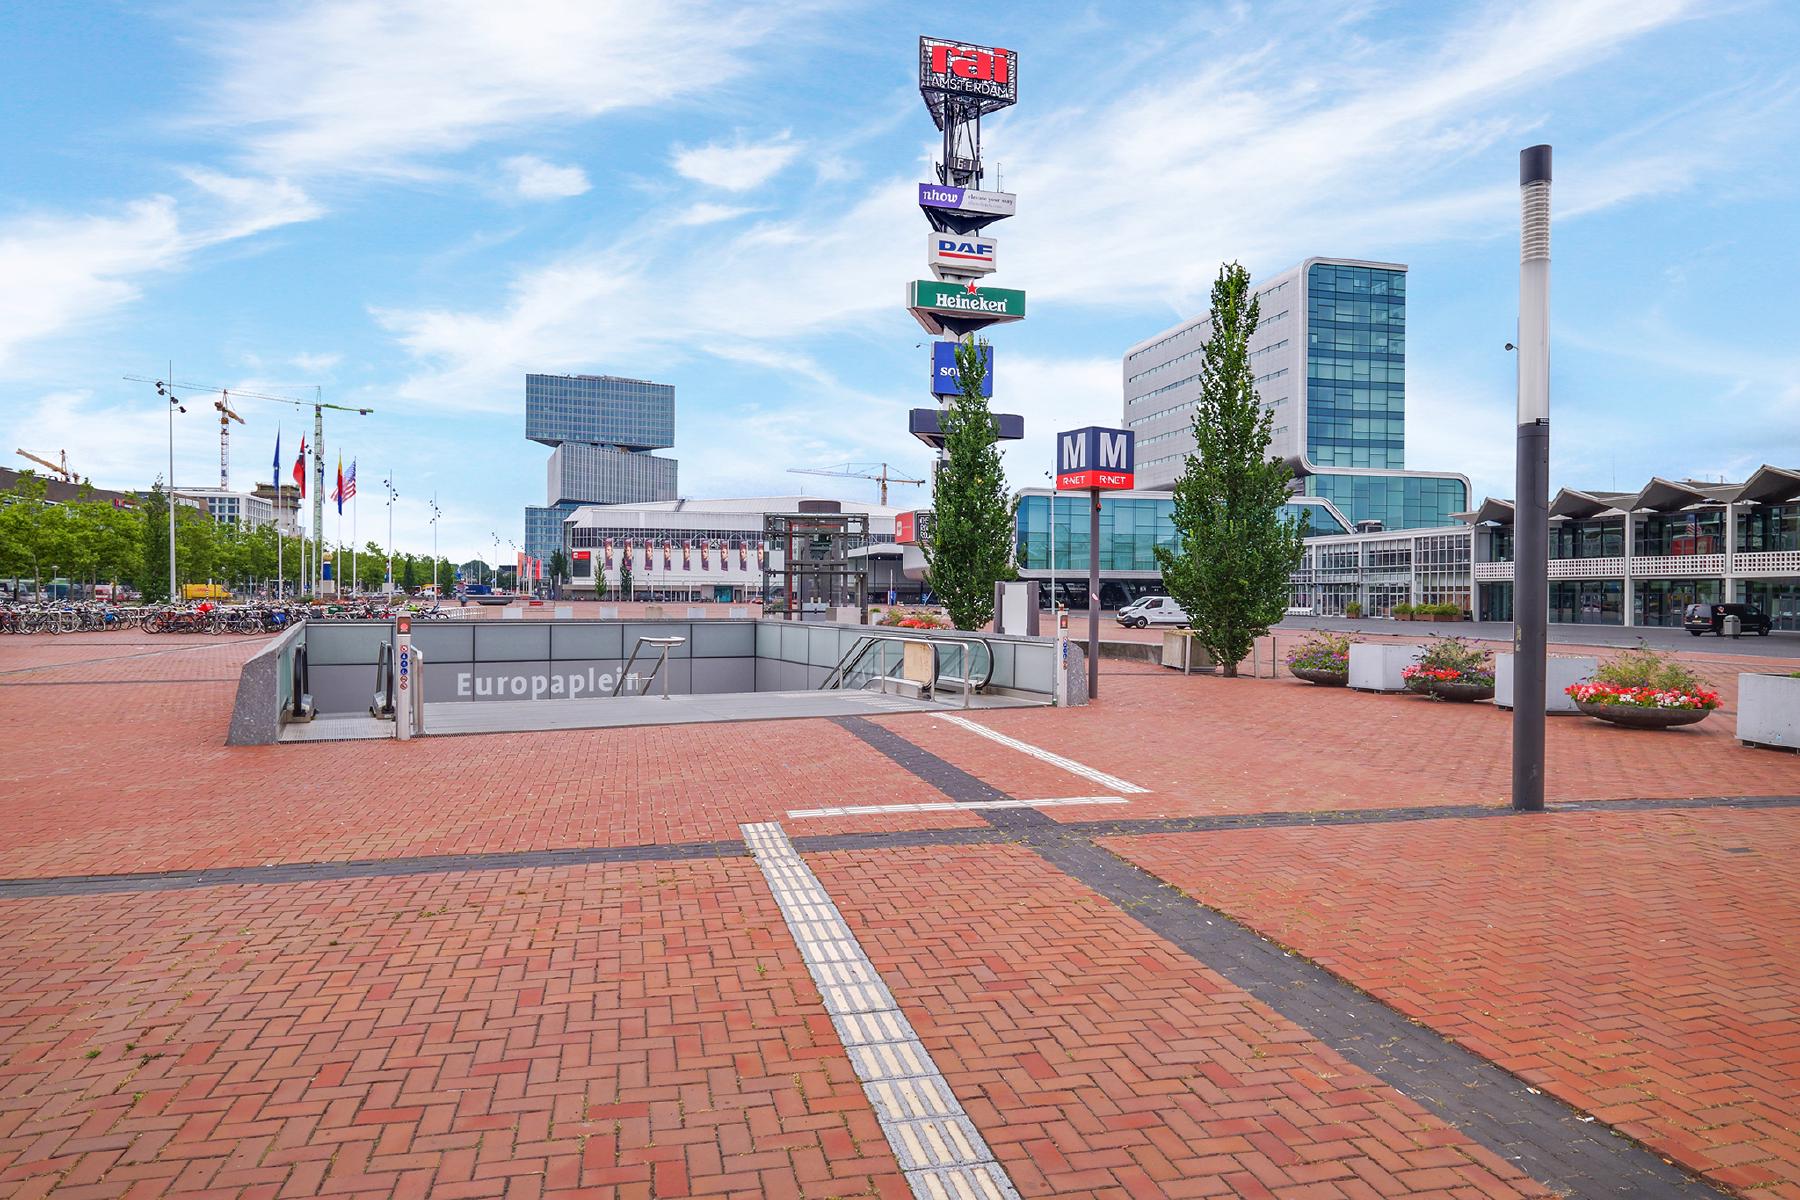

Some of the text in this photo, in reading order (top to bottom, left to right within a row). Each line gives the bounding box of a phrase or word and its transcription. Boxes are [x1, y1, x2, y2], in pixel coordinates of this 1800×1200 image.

[932, 46, 1008, 83] rai
[931, 77, 1008, 96] AMSTERDAM
[922, 190, 958, 203] nhow
[939, 240, 993, 255] DAF
[935, 293, 1008, 312] Heineken
[1063, 432, 1086, 470] M
[1100, 432, 1127, 469] M
[457, 666, 640, 700] Europaplein
